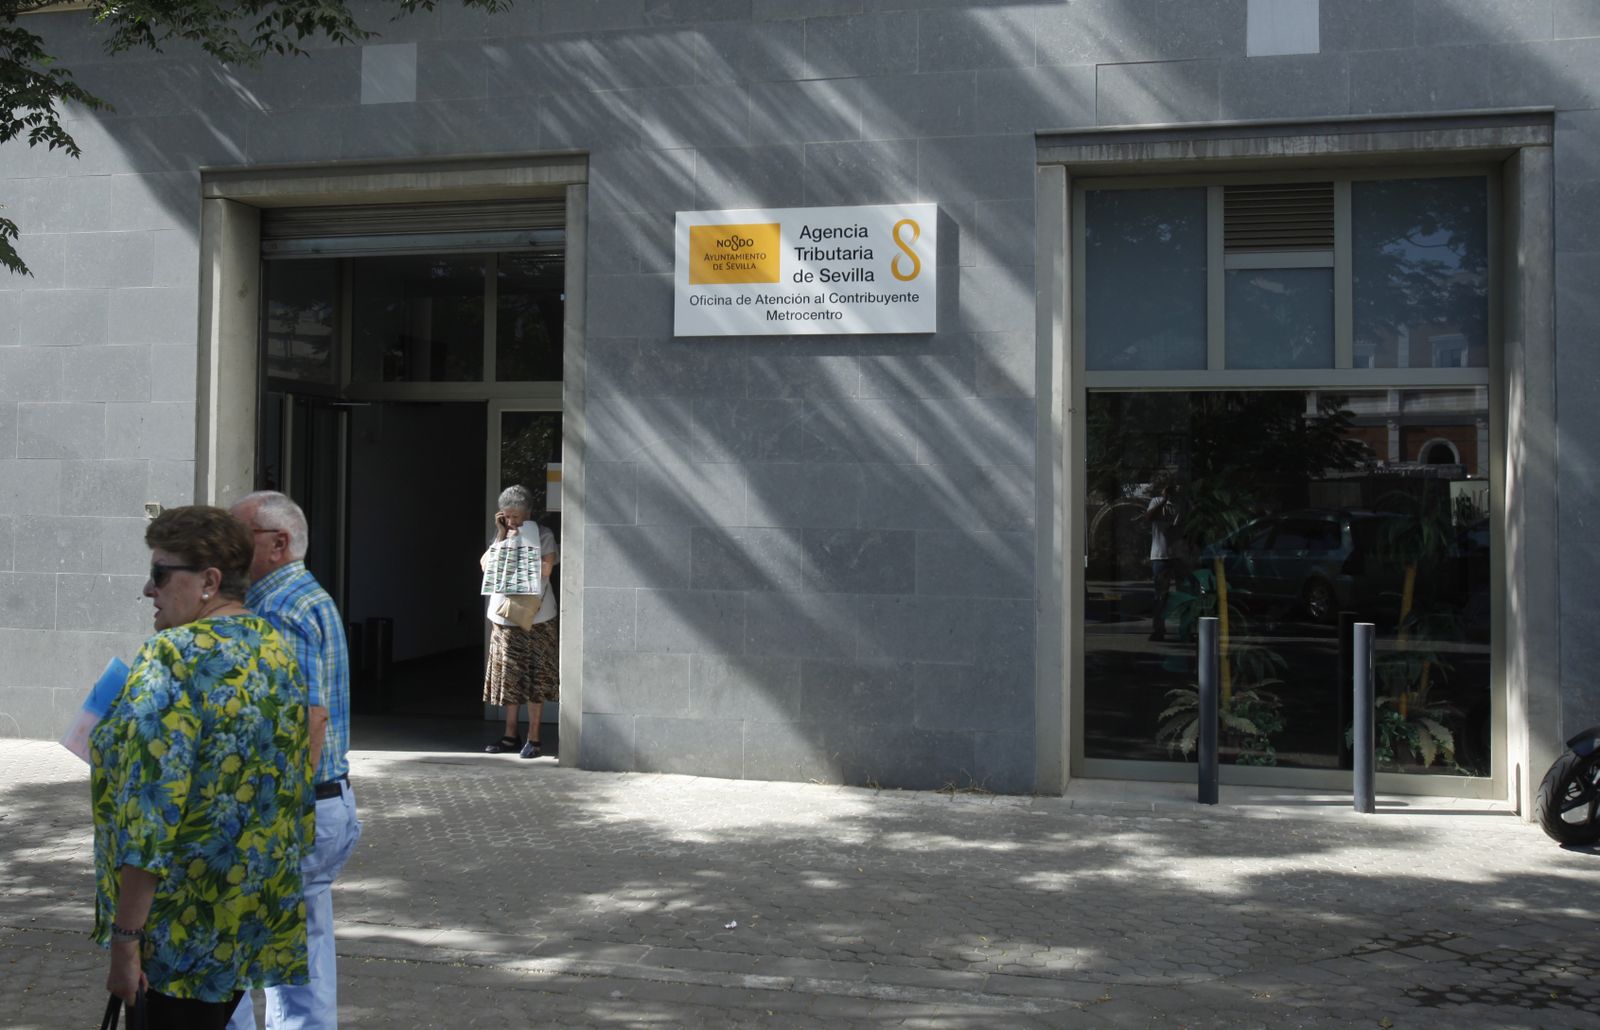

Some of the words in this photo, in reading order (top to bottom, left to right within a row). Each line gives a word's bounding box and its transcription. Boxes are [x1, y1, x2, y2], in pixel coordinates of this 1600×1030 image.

[800, 224, 868, 242] Agencia
[794, 245, 873, 261] Tributaria
[793, 269, 813, 283] de
[819, 268, 874, 282] Sevilla
[689, 293, 732, 306] Oficina
[736, 293, 751, 305] de
[755, 292, 810, 304] Atención
[815, 292, 825, 304] al
[829, 292, 919, 305] Contribuyente
[766, 309, 843, 321] Metrocentro
